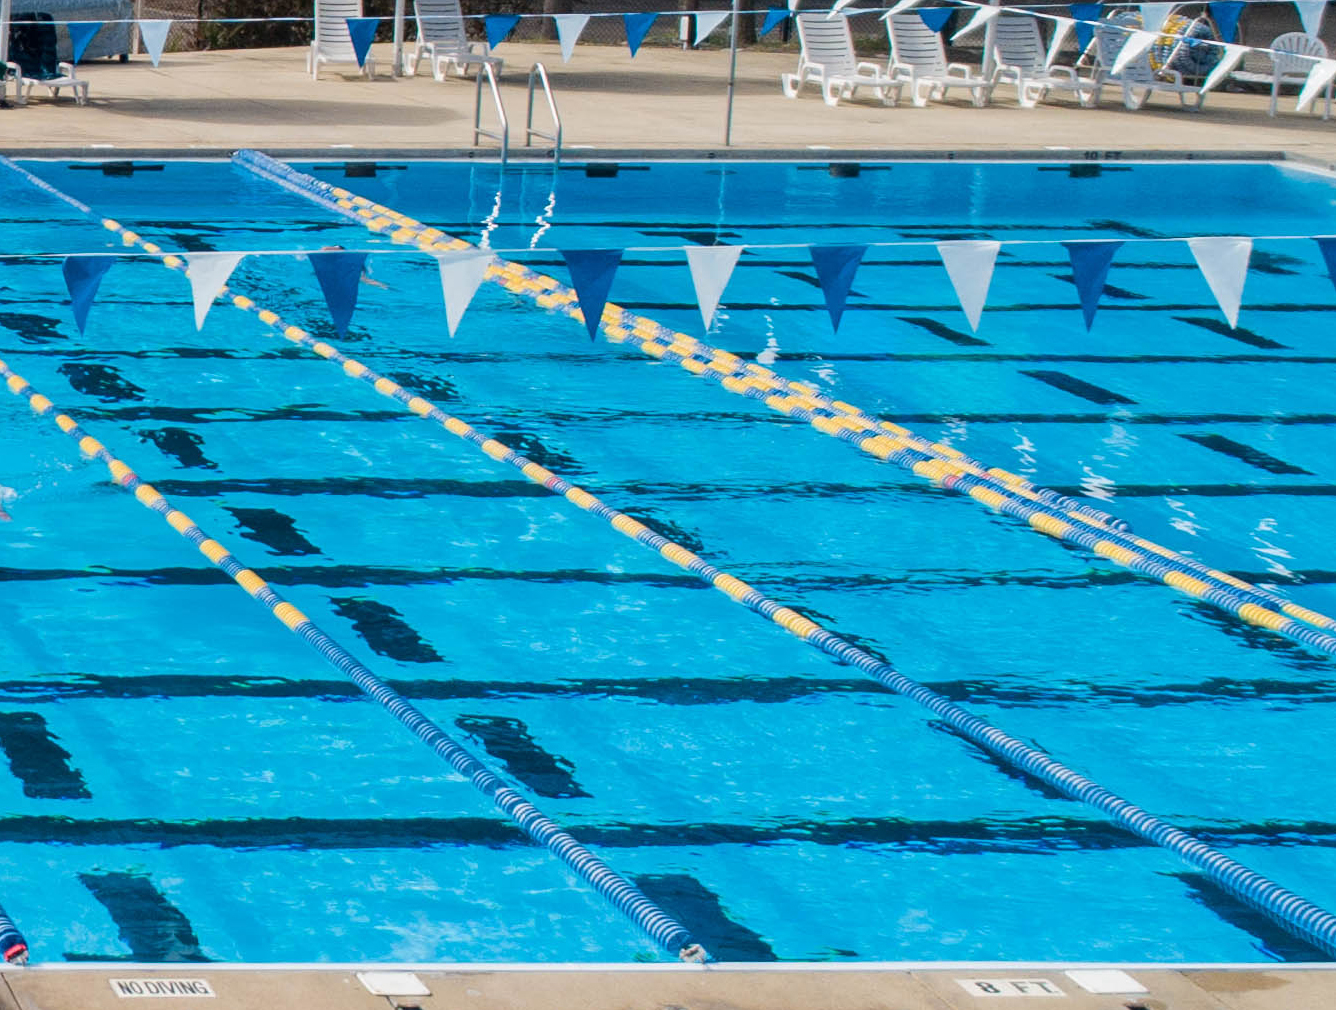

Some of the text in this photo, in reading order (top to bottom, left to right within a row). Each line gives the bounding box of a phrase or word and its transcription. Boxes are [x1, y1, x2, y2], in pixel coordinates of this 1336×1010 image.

[1084, 151, 1122, 160] 10 FT
[117, 981, 209, 995] NO DIVING
[974, 982, 1001, 994] 8
